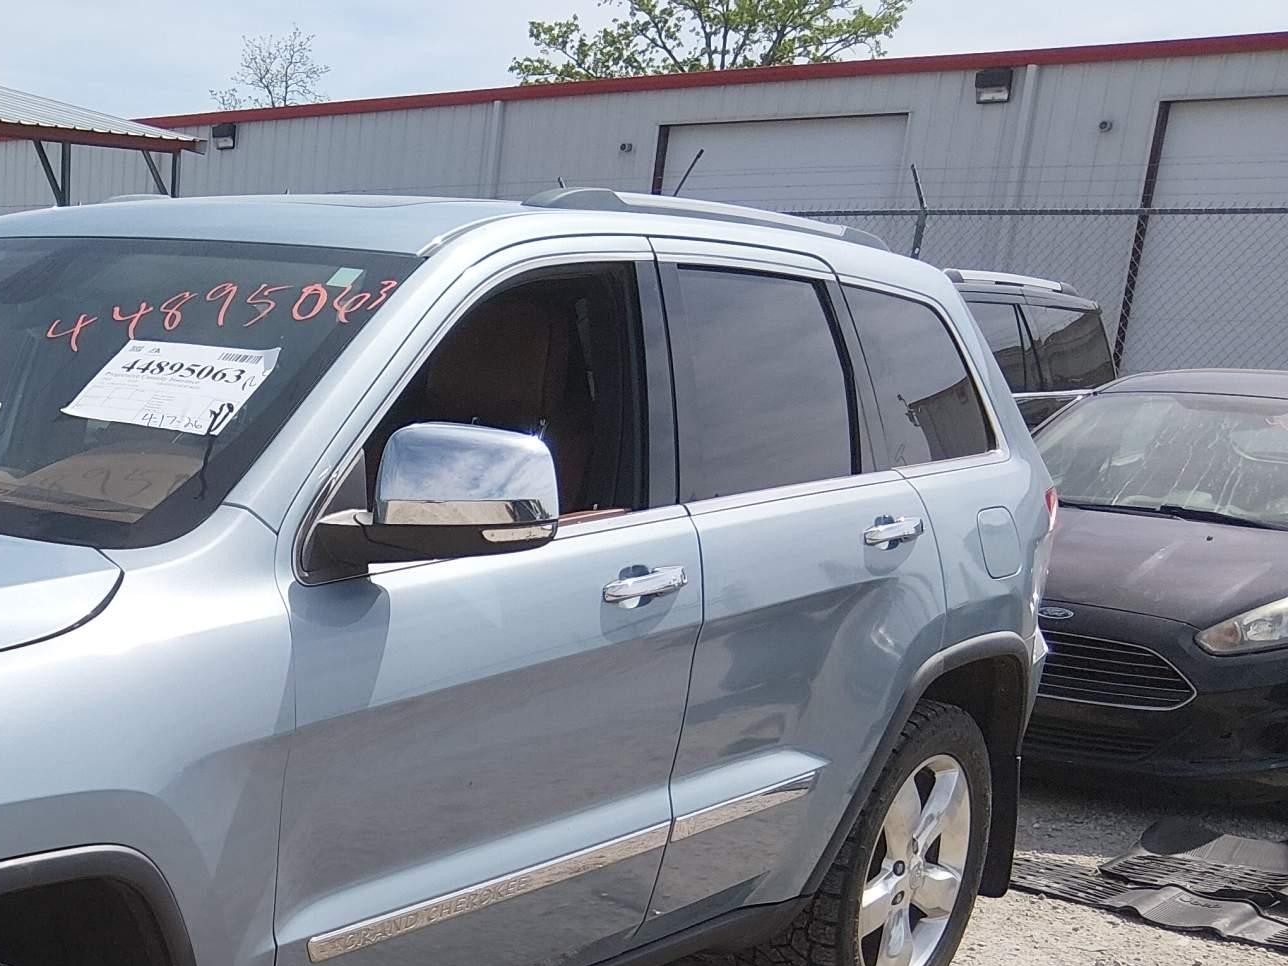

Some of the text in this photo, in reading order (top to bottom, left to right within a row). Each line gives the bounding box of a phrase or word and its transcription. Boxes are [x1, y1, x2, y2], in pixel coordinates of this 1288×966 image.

[47, 280, 397, 352] 44895063
[122, 358, 246, 384] 44895063
[343, 877, 530, 951] GRAND CHEROKEE
